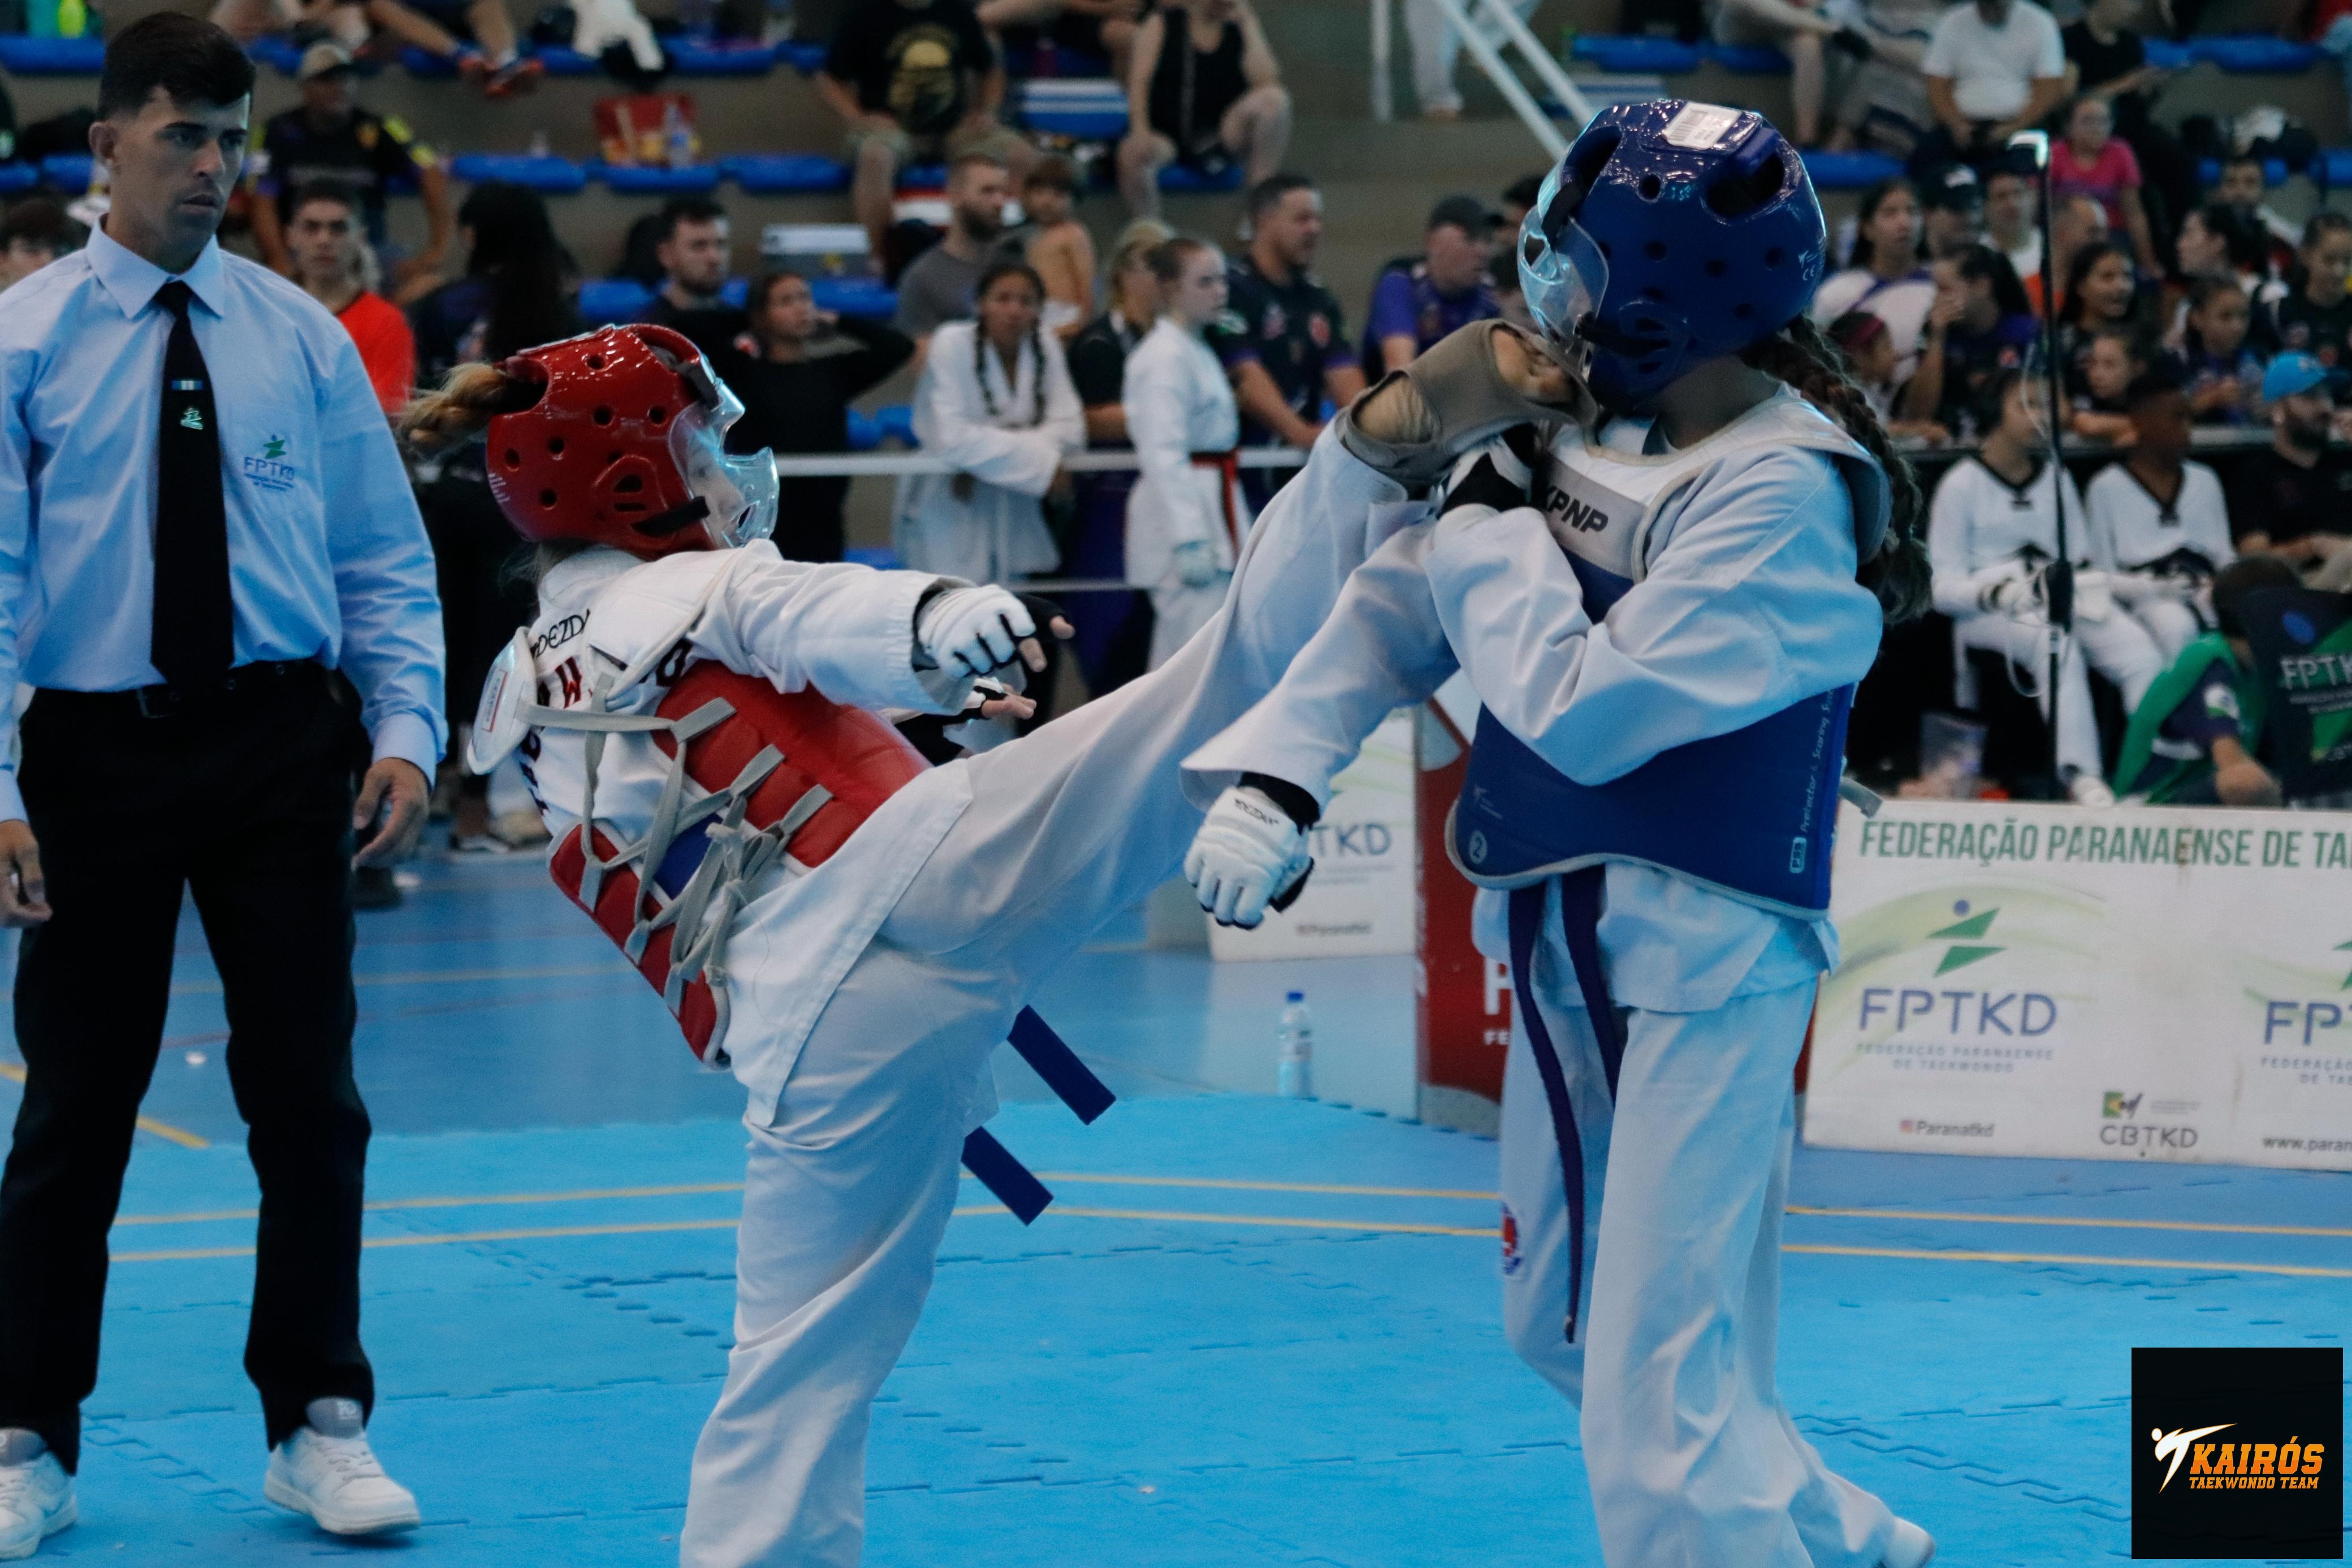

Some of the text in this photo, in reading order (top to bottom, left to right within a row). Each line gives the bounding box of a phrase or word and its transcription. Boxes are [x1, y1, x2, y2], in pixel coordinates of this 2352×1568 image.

[1310, 822, 1392, 857] TKD
[1860, 818, 2352, 869] FEDERAÇÃO PARANAENSE DE TA
[1860, 988, 2057, 1037] FPTKD
[2264, 1001, 2352, 1046] FP
[2100, 1125, 2198, 1148] CBTKD
